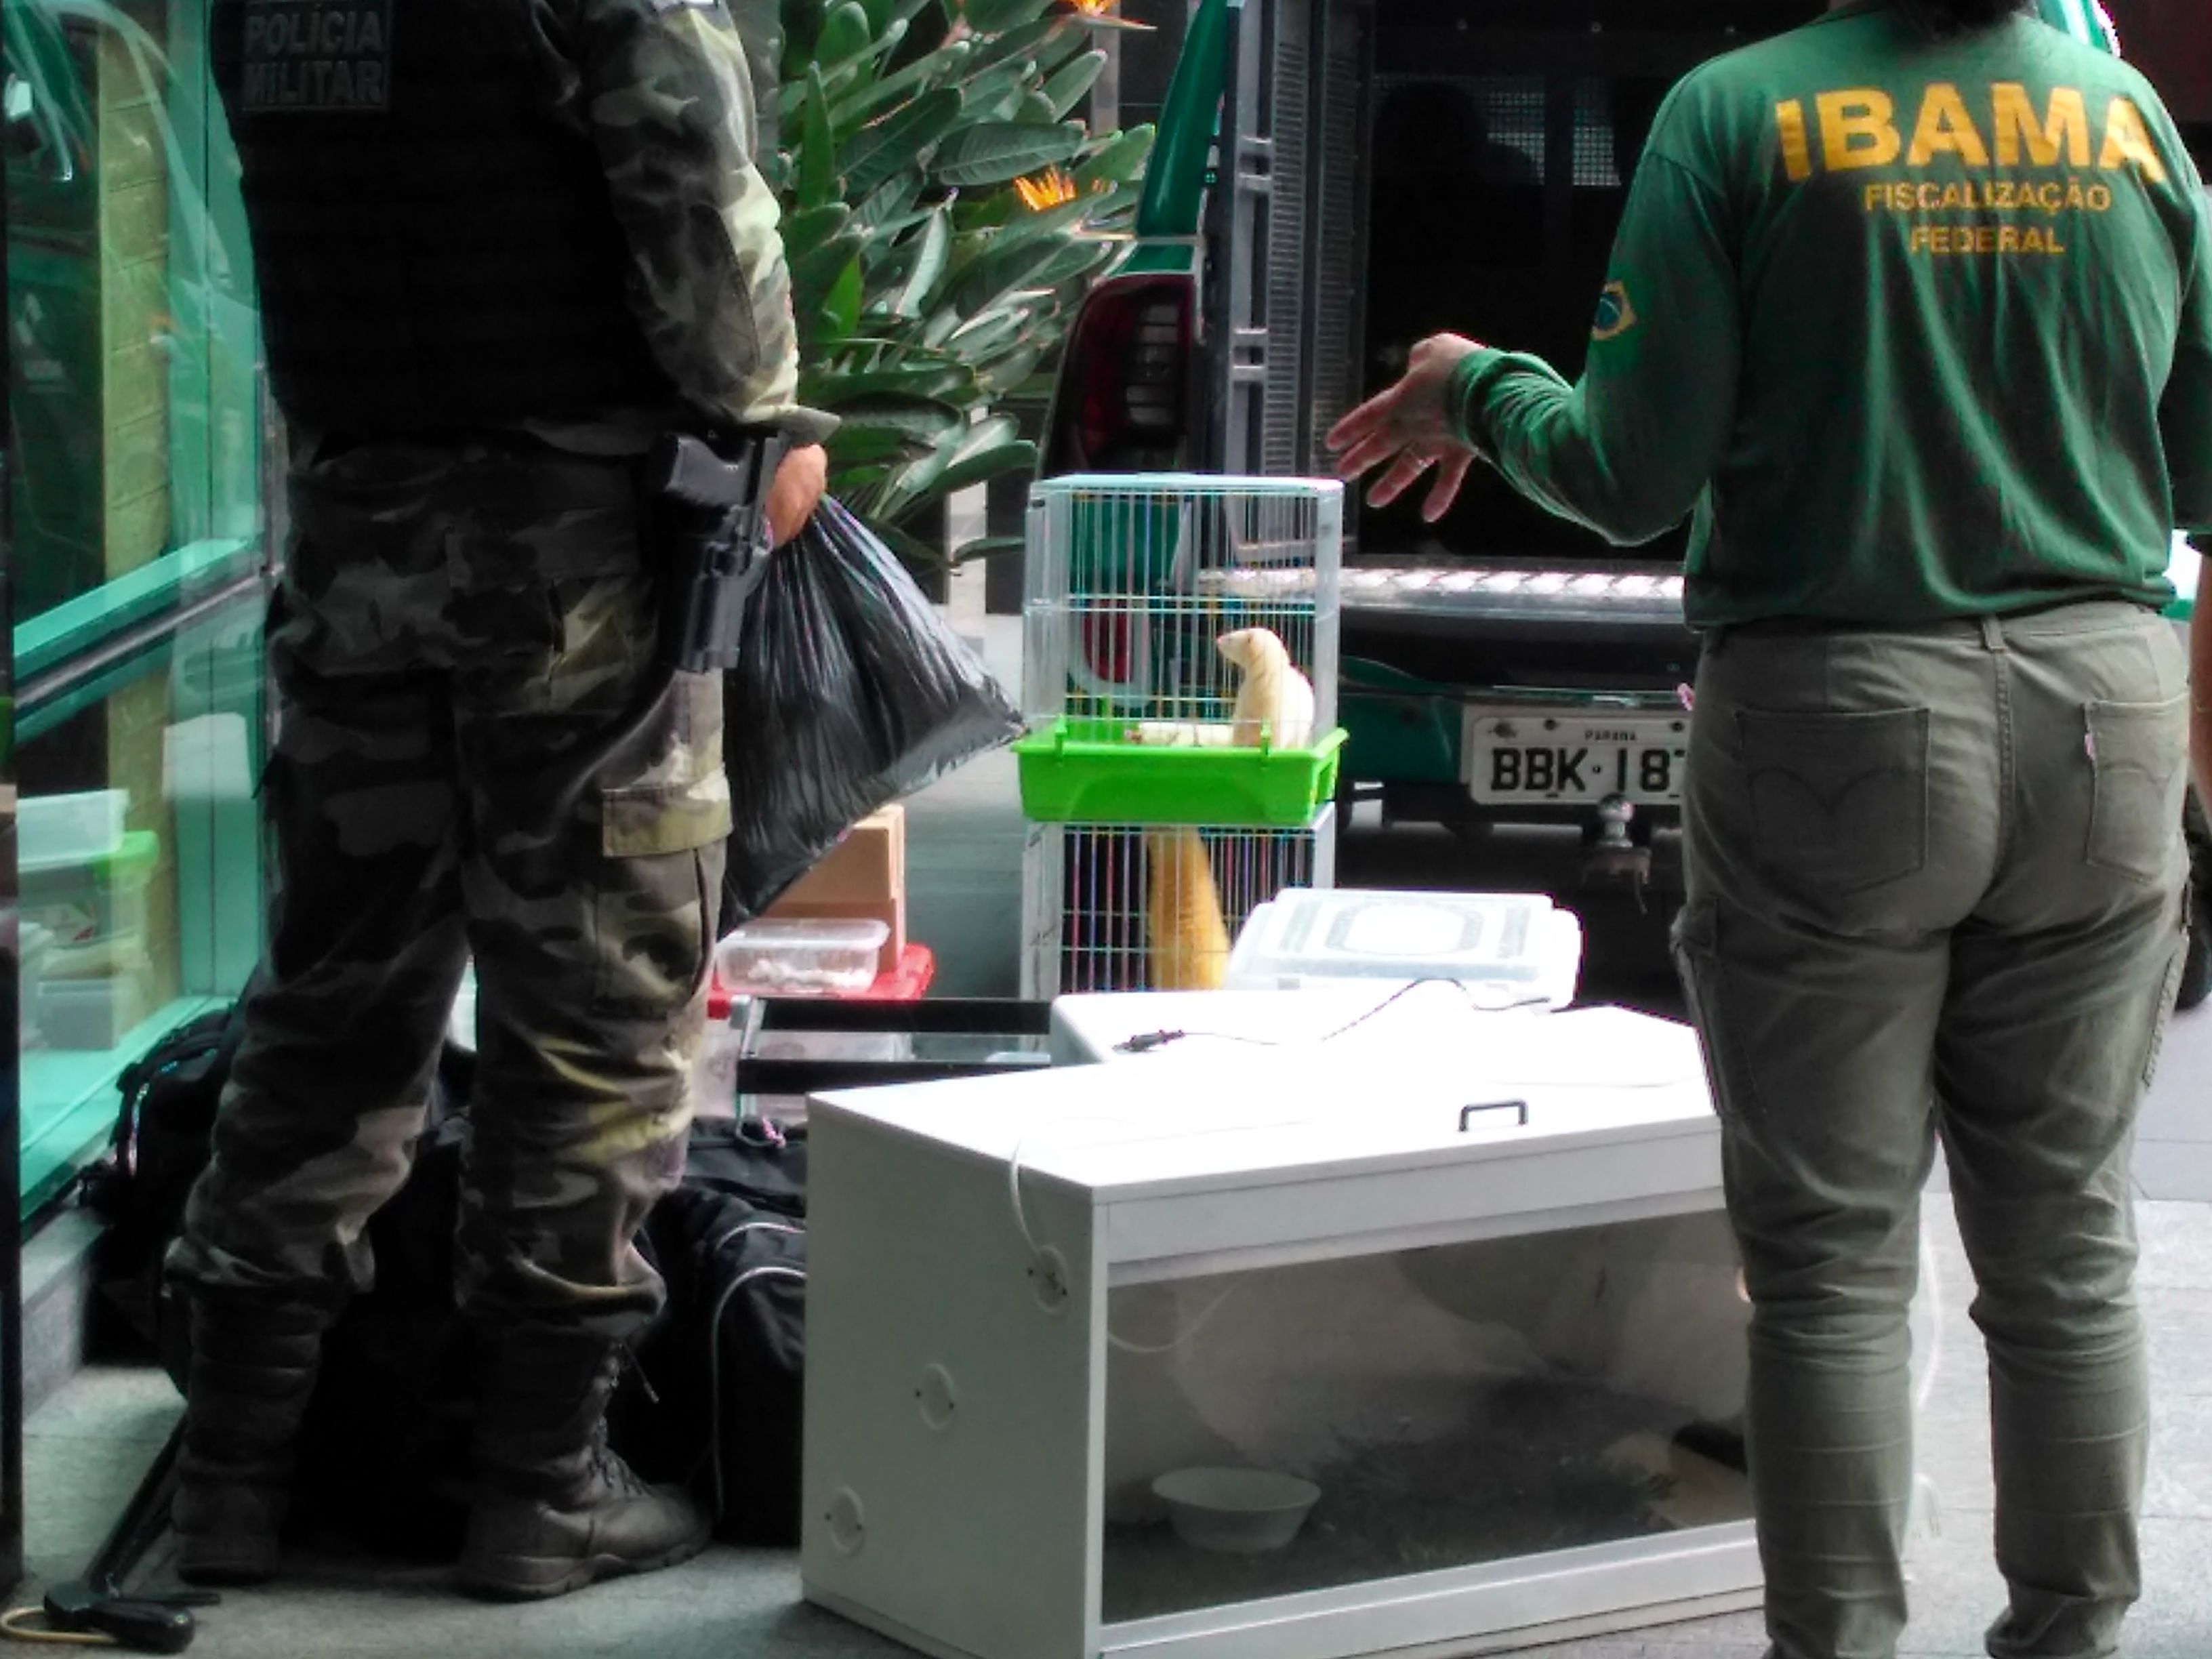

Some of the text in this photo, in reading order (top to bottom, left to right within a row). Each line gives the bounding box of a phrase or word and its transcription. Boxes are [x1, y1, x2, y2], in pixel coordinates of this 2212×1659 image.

[243, 60, 384, 106] MILITAR
[1775, 82, 2167, 182] IBAMA
[1864, 178, 2112, 216] FISCALIZAÇÃO
[1910, 226, 2066, 255] FEDERAL
